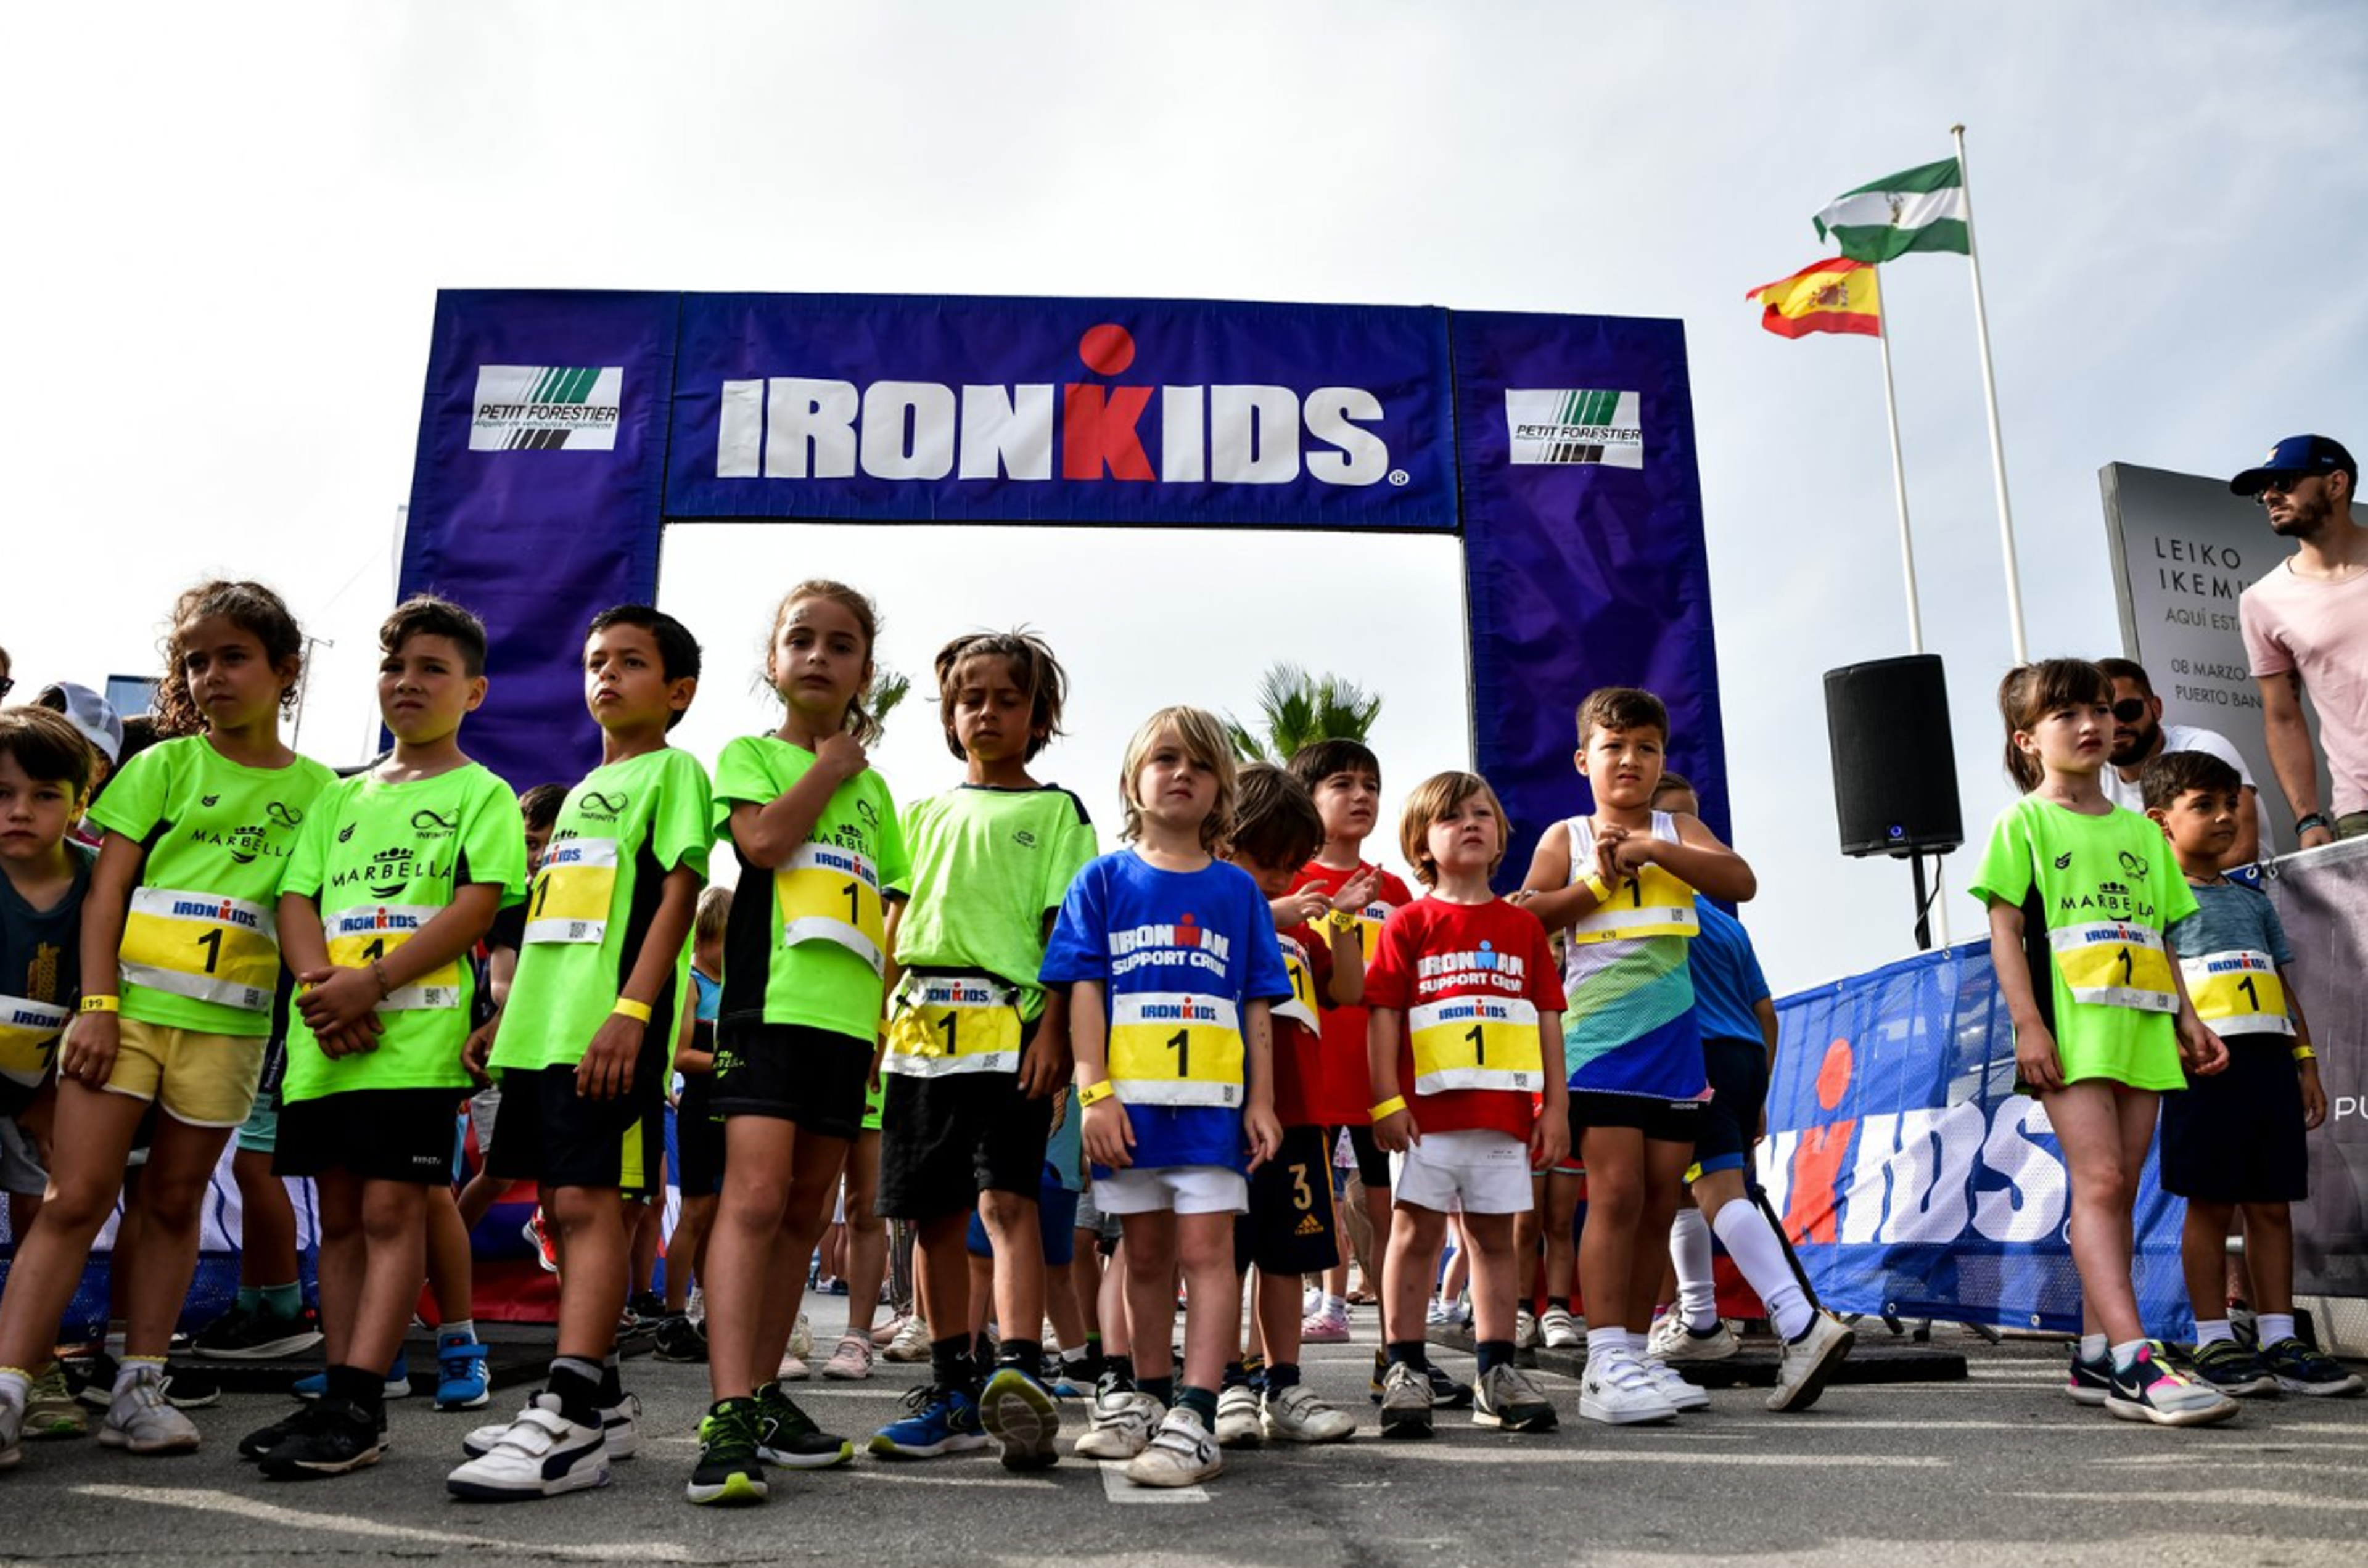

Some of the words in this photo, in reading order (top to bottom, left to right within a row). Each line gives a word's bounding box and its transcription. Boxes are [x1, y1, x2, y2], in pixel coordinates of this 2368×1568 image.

[479, 404, 526, 419] PETIT
[527, 405, 618, 421] FORESTIER
[717, 324, 1389, 486] IRONKIDS
[1517, 425, 1558, 436] PETIT
[1561, 426, 1642, 440] FORESTIER
[2155, 536, 2241, 569] LEIKO
[2165, 607, 2206, 627] AQUÍ
[2171, 658, 2189, 675] 08
[2193, 662, 2246, 682] MARZO
[2175, 684, 2227, 705] PUERTO
[2232, 692, 2263, 708] BAN
[332, 860, 451, 889] MARBELLA
[535, 872, 551, 917] 1
[842, 882, 858, 925] 1
[1624, 878, 1640, 908] 1
[173, 900, 257, 927] IRONKIDS
[340, 907, 418, 932] IRONKIDS
[1108, 913, 1230, 962] IRONMAN
[2085, 924, 2145, 943] IRONKIDS
[198, 928, 223, 974] 1
[1112, 950, 1187, 975] SUPPORT
[1417, 940, 1526, 980] IRONMAN
[2207, 953, 2267, 973] IRONKIDS
[2118, 947, 2132, 985] 1
[925, 980, 989, 1002] ONKIDS
[1289, 964, 1304, 1000] 1
[1419, 972, 1488, 995] SUPPORT
[2237, 975, 2261, 1012] 1
[12, 1009, 60, 1028] IRON
[1141, 996, 1217, 1021] IRONKIDS
[1439, 999, 1508, 1020] IRONKIDS
[937, 1010, 957, 1055] 1
[1465, 1024, 1484, 1065] 1
[1167, 1028, 1188, 1078] 1
[1289, 1163, 1312, 1210] 3
